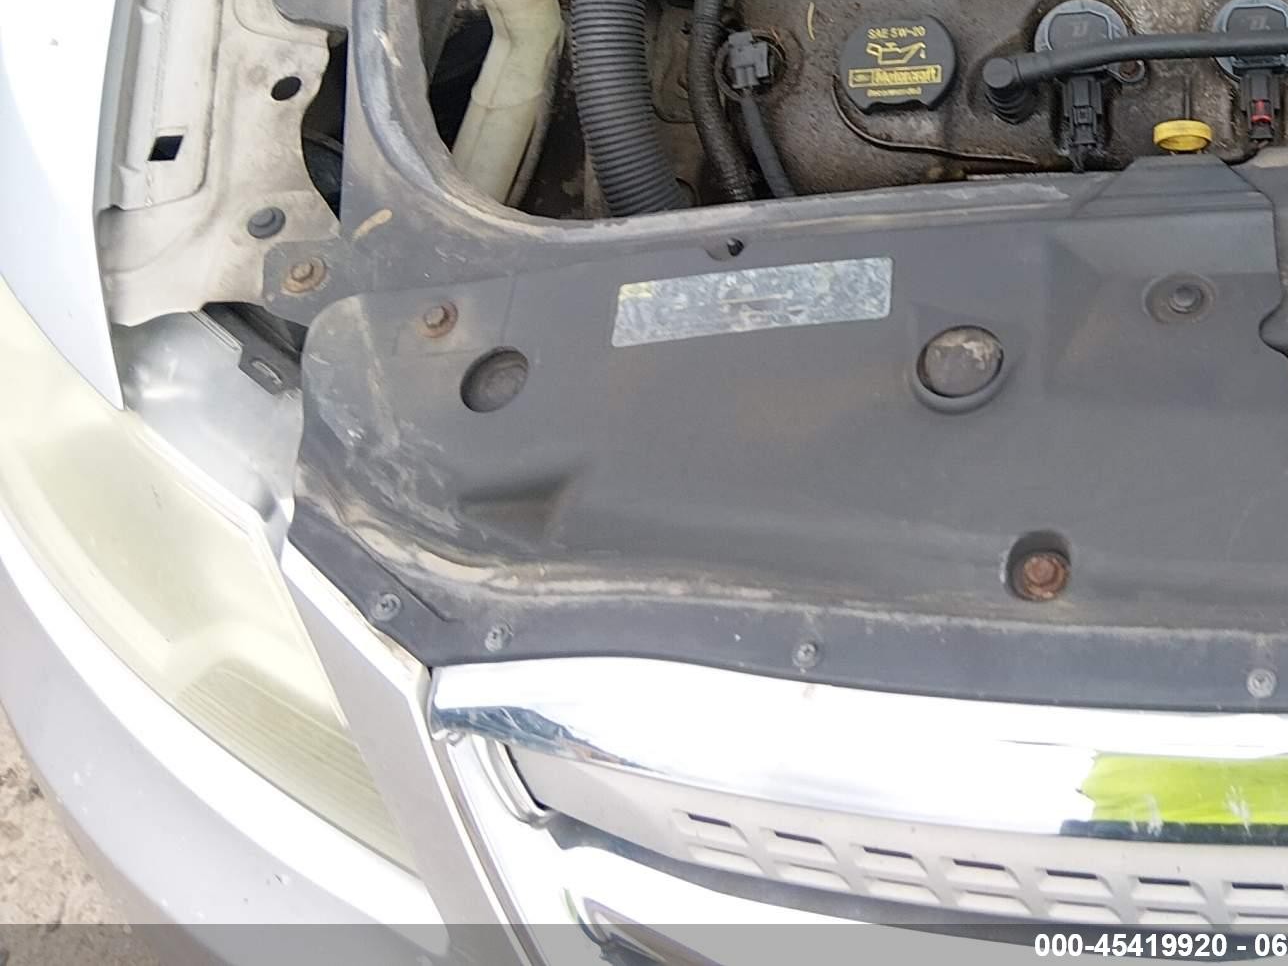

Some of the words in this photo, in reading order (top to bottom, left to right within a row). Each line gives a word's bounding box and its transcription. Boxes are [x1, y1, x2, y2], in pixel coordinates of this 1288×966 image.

[868, 28, 889, 39] SAE
[890, 26, 926, 37] 5W-20
[874, 67, 936, 84] Motorcraft
